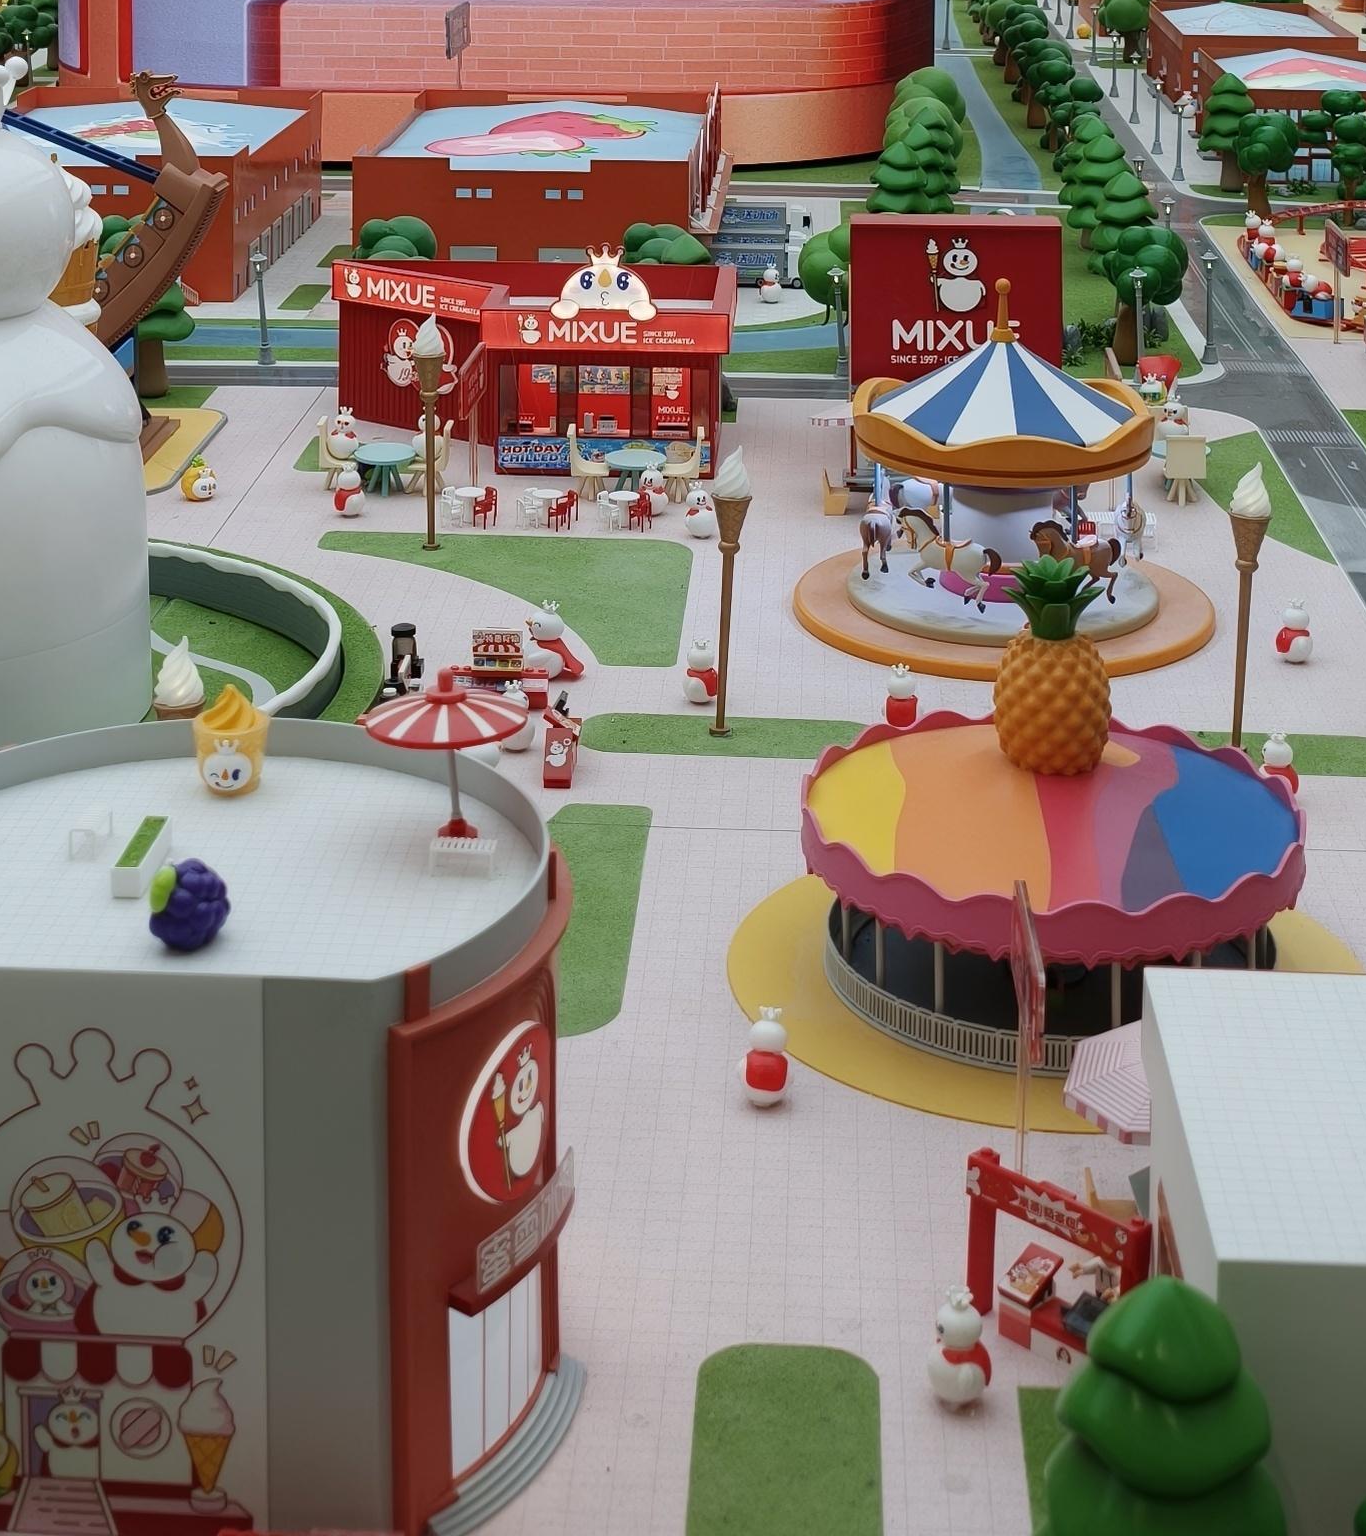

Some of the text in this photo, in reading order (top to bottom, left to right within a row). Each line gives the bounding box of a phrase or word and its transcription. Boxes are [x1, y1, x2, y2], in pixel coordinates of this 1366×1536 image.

[366, 276, 436, 309] MIXUE
[548, 320, 638, 344] MIXUE
[890, 354, 917, 364] SINCE
[920, 354, 938, 364] 1997
[657, 405, 685, 415] MIXUE
[501, 444, 563, 454] HOT DAY
[501, 453, 562, 464] CHILLED
